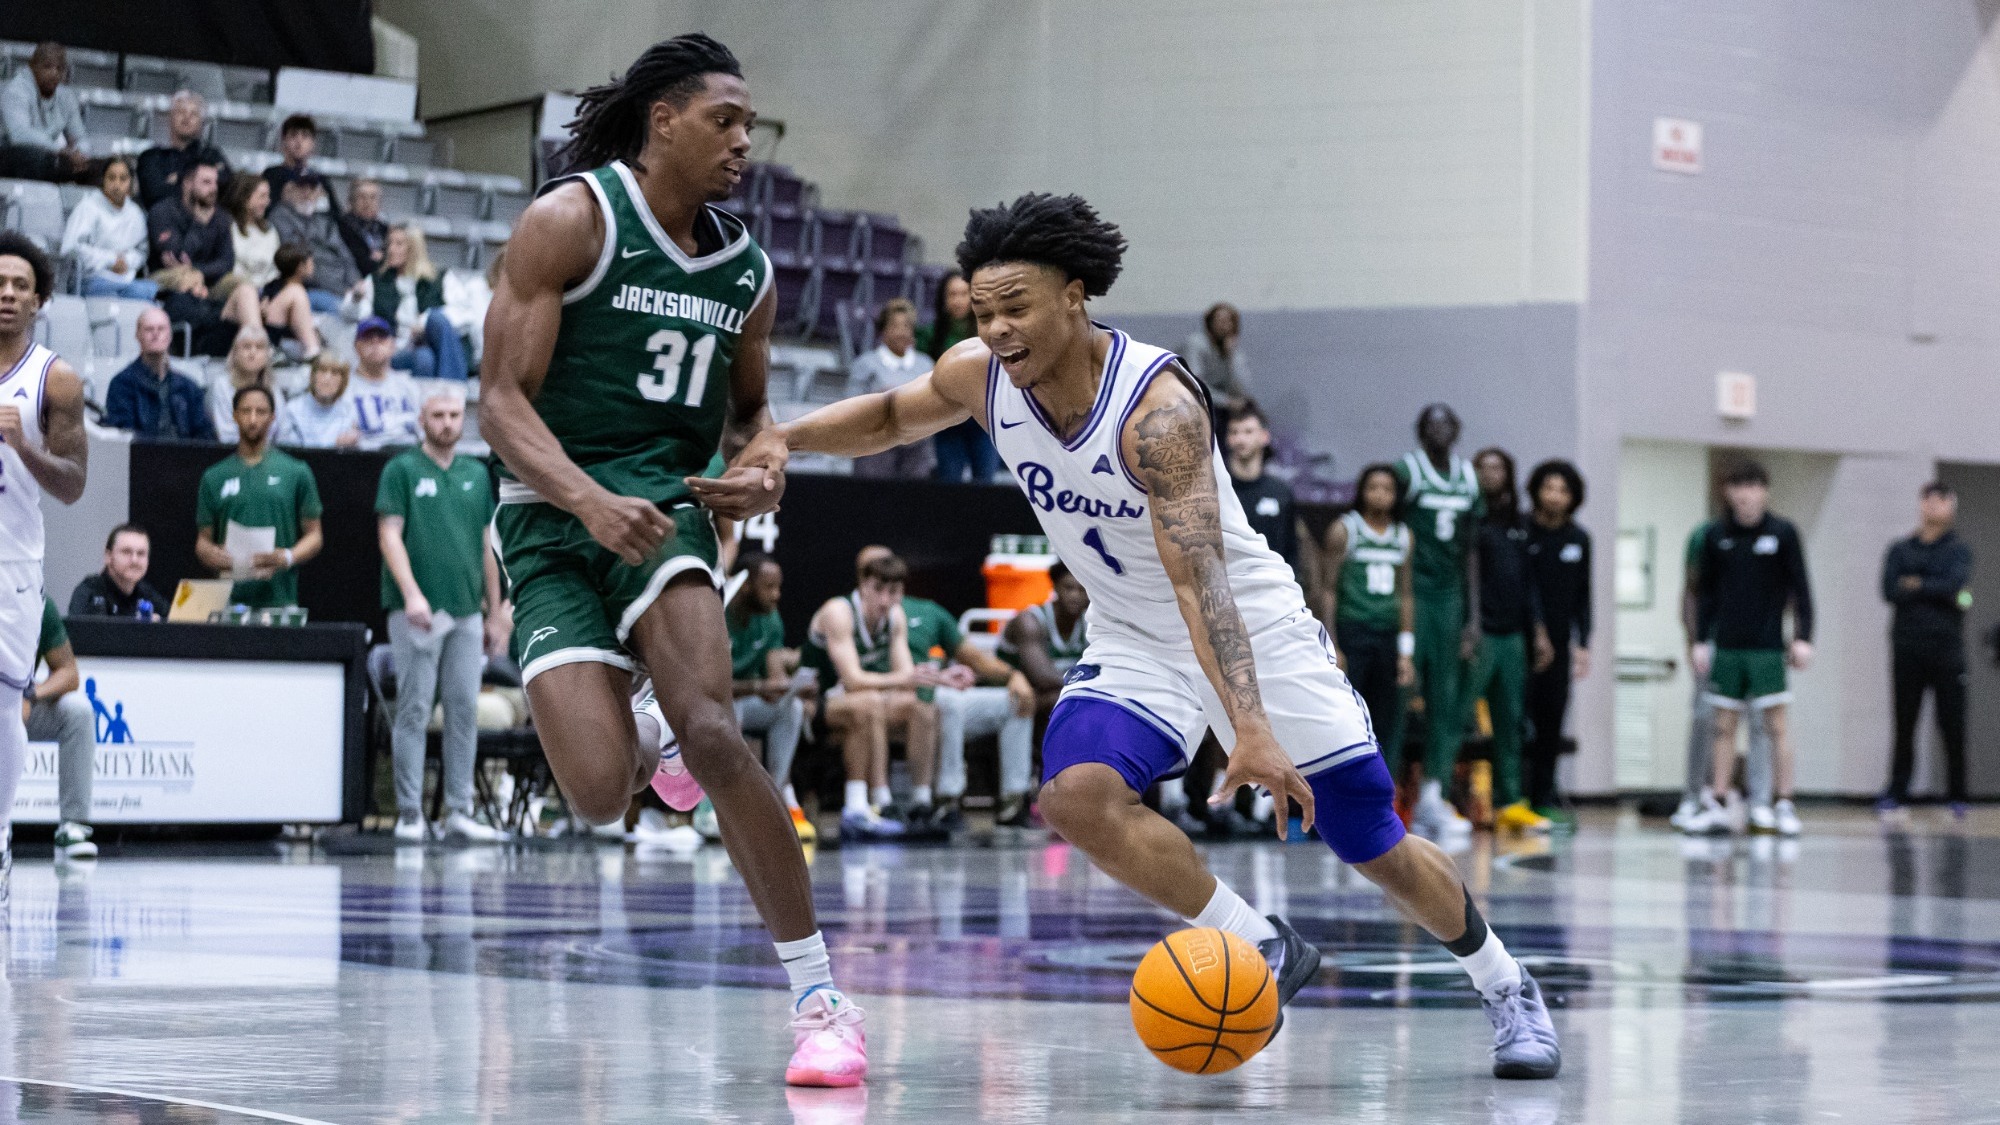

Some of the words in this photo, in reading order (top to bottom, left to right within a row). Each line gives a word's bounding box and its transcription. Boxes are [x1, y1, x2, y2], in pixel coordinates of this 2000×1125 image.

[636, 329, 717, 408] 31
[1017, 461, 1145, 519] Bears
[733, 510, 780, 553] 4
[1082, 526, 1125, 575] 1
[141, 748, 194, 777] BANK
